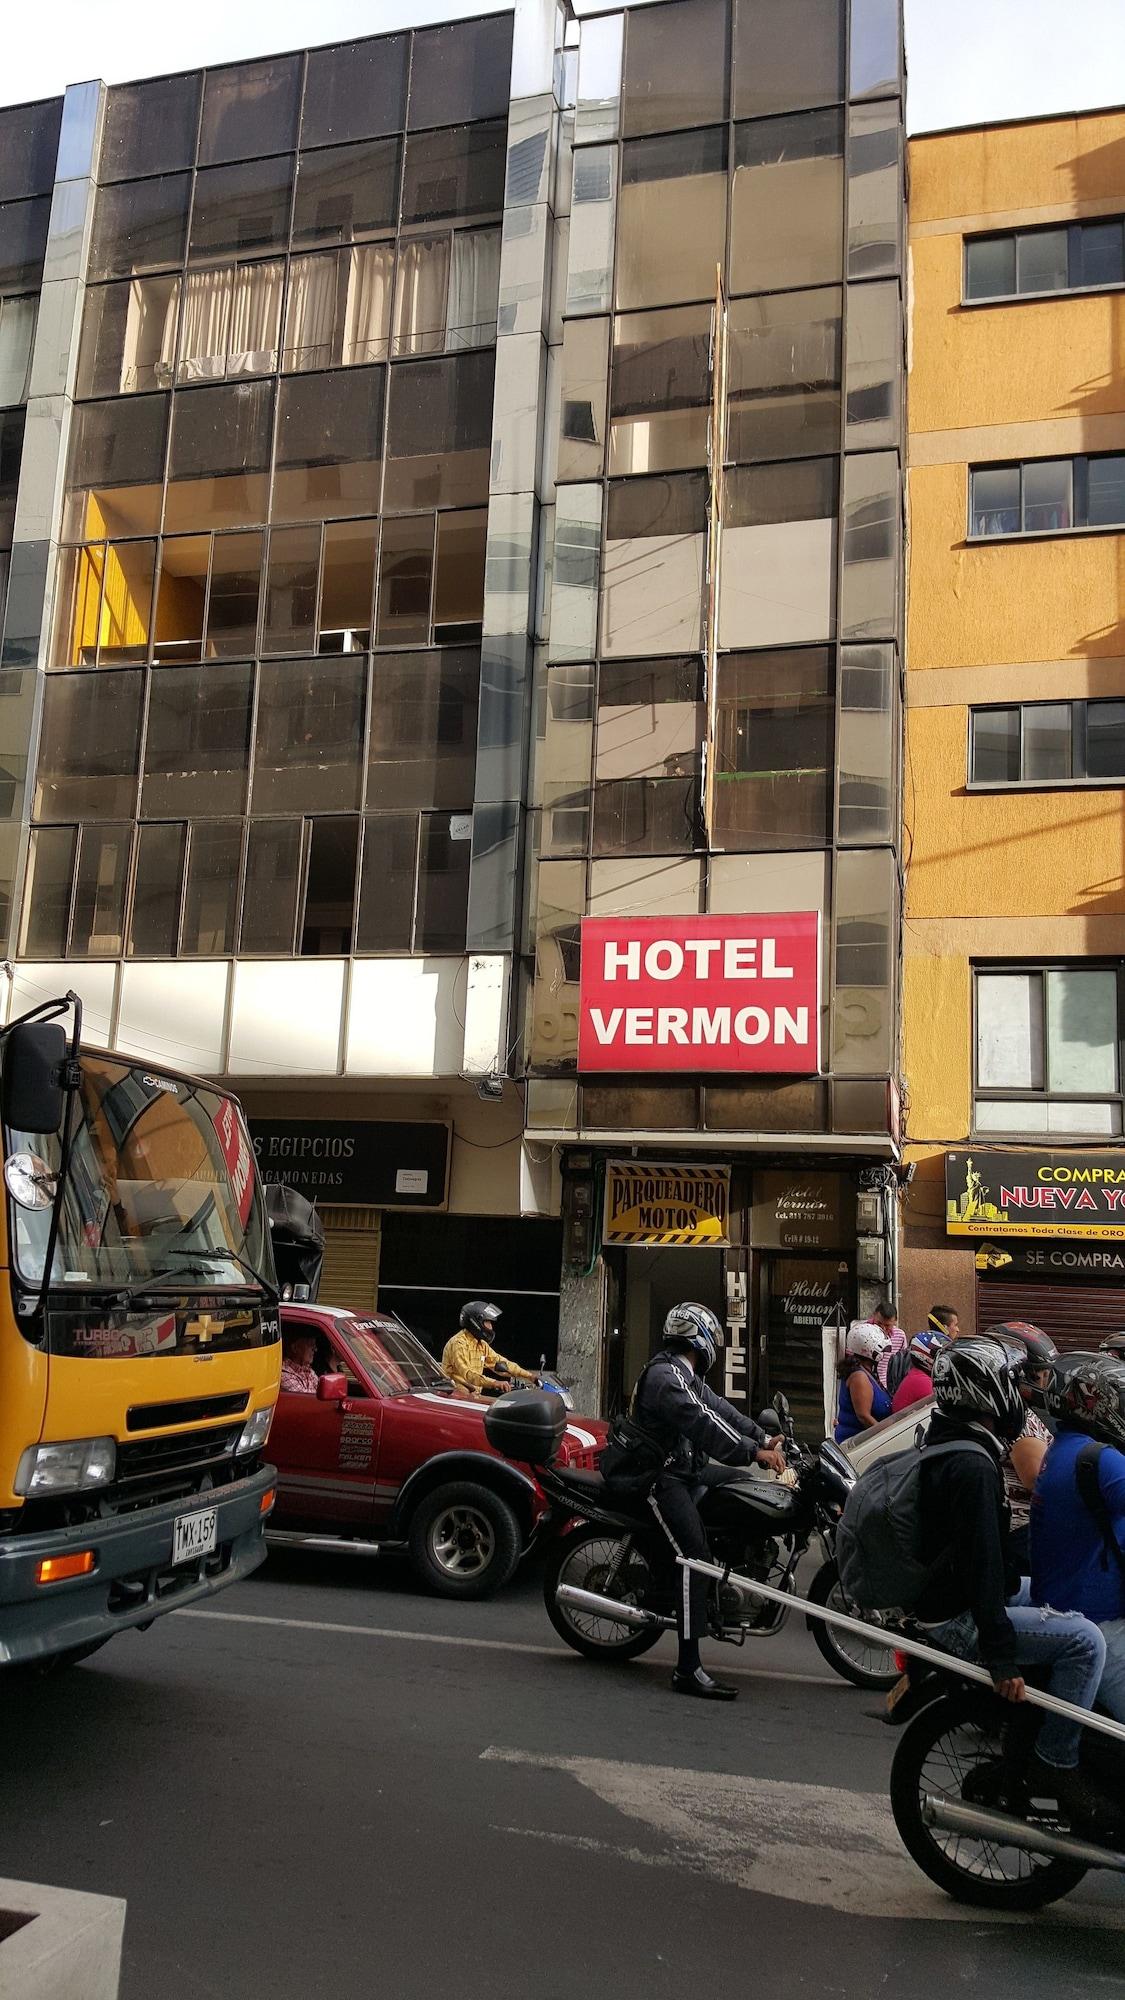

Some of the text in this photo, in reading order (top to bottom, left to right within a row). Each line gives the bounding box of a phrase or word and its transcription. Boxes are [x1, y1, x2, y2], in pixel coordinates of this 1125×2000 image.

[604, 938, 793, 981] HOTEL
[589, 1006, 808, 1045] VERMON
[268, 1136, 355, 1158] EGIPCIOS
[611, 1178, 726, 1223] PARQUEADERO
[1000, 1185, 1125, 1211] NUEVA Y
[638, 1206, 698, 1231] MOTOS
[967, 1225, 1028, 1234] Contratamos
[1032, 1227, 1054, 1235] Toda
[1057, 1227, 1080, 1236] Clase
[1101, 1229, 1124, 1237] ORO
[1026, 1249, 1045, 1265] SE
[788, 1279, 831, 1298] Hotel
[780, 1297, 834, 1315] Vermon
[260, 1321, 279, 1336] FVR
[793, 1315, 823, 1326] ABIERTO
[72, 1328, 120, 1341] TURBO
